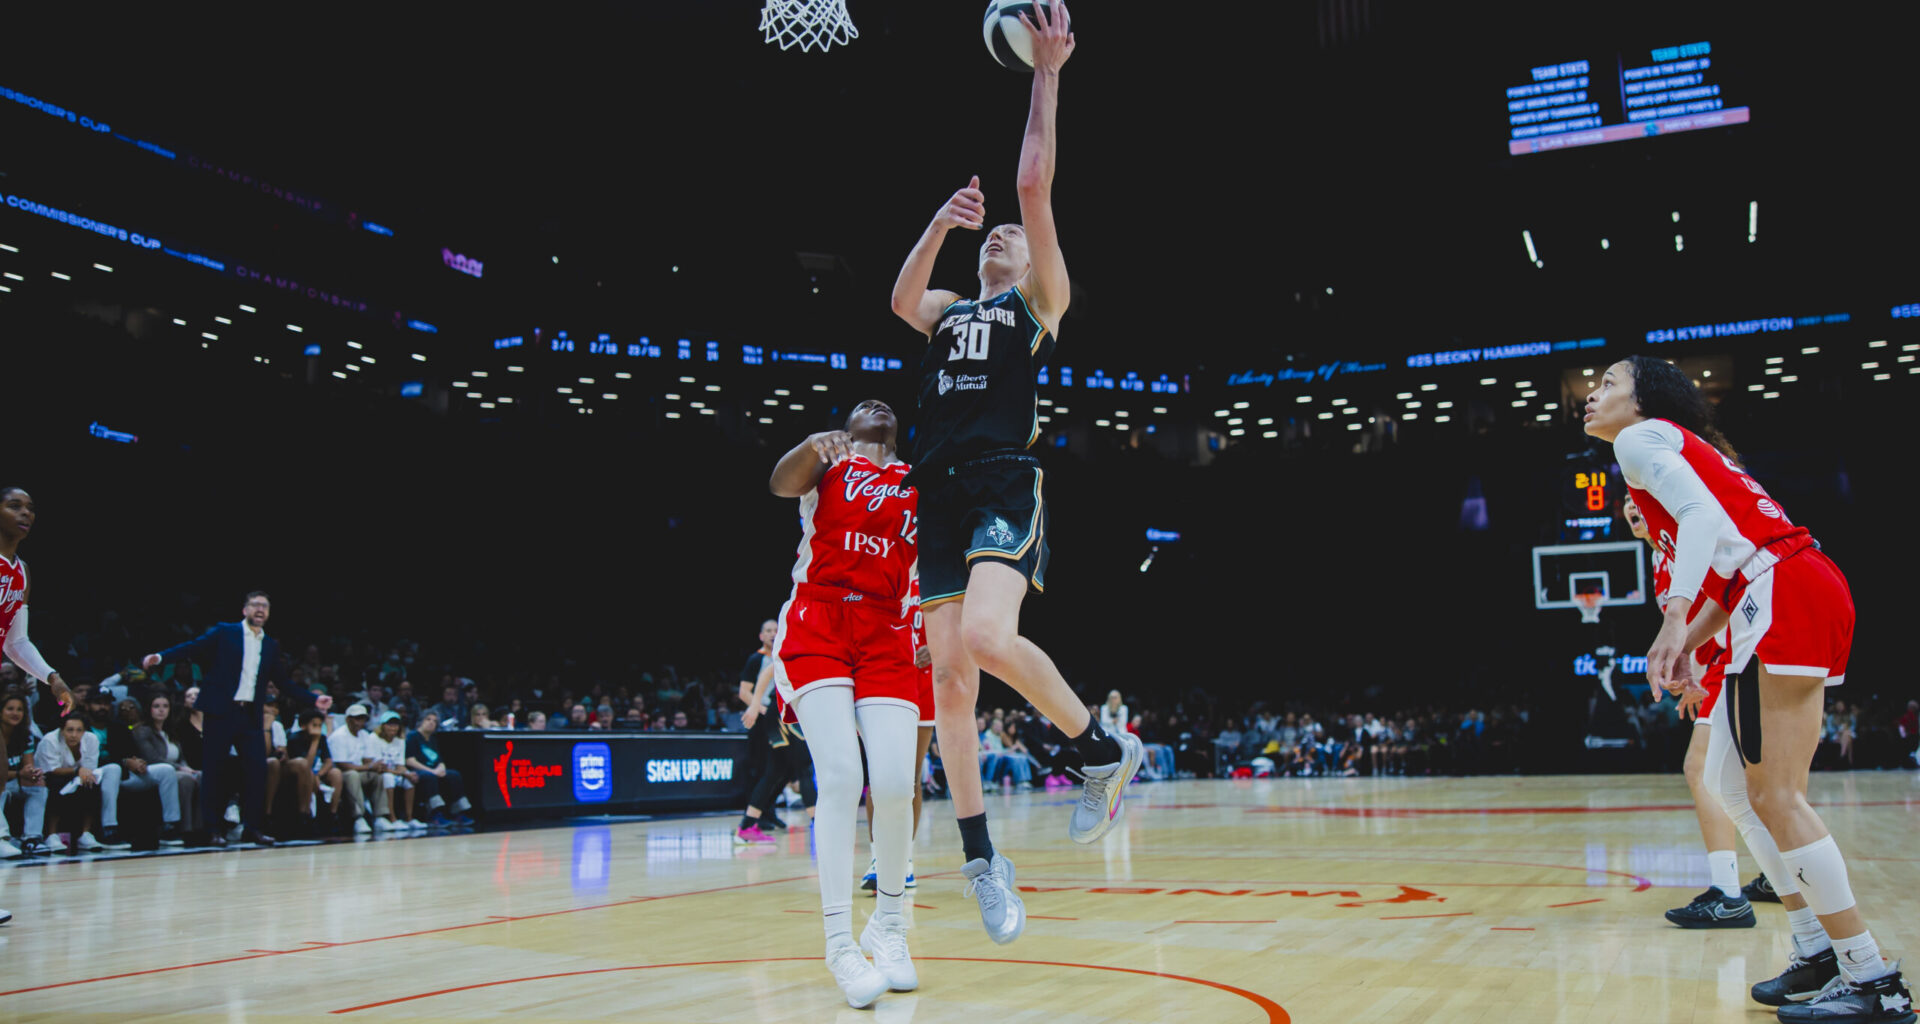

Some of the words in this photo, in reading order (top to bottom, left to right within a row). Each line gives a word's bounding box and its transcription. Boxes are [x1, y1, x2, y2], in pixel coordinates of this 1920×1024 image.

[79, 116, 111, 133] CUP
[6, 194, 128, 242] COMMISSIONER'S
[130, 233, 162, 249] CUP
[936, 313, 974, 336] NEW
[976, 303, 1016, 328] YORK
[1646, 328, 1675, 343] #34
[1676, 325, 1713, 341] KYM
[1714, 316, 1794, 336] HAMPTON
[947, 321, 991, 361] 30
[830, 353, 848, 370] 51
[1434, 349, 1481, 365] BECKY
[1483, 341, 1551, 360] HAMMON
[954, 381, 987, 392] Mutual
[955, 374, 988, 384] Liberty
[843, 465, 872, 483] Las
[844, 473, 914, 512] Vegas
[1587, 485, 1604, 511] 8
[844, 531, 895, 558] IPSY
[842, 592, 863, 602] Aces
[580, 753, 604, 768] prime
[511, 765, 563, 777] LEAGUE
[581, 767, 605, 779] video
[647, 759, 681, 782] SIGN
[682, 759, 701, 781] UP
[701, 758, 734, 781] NOW
[511, 776, 545, 788] PASS
